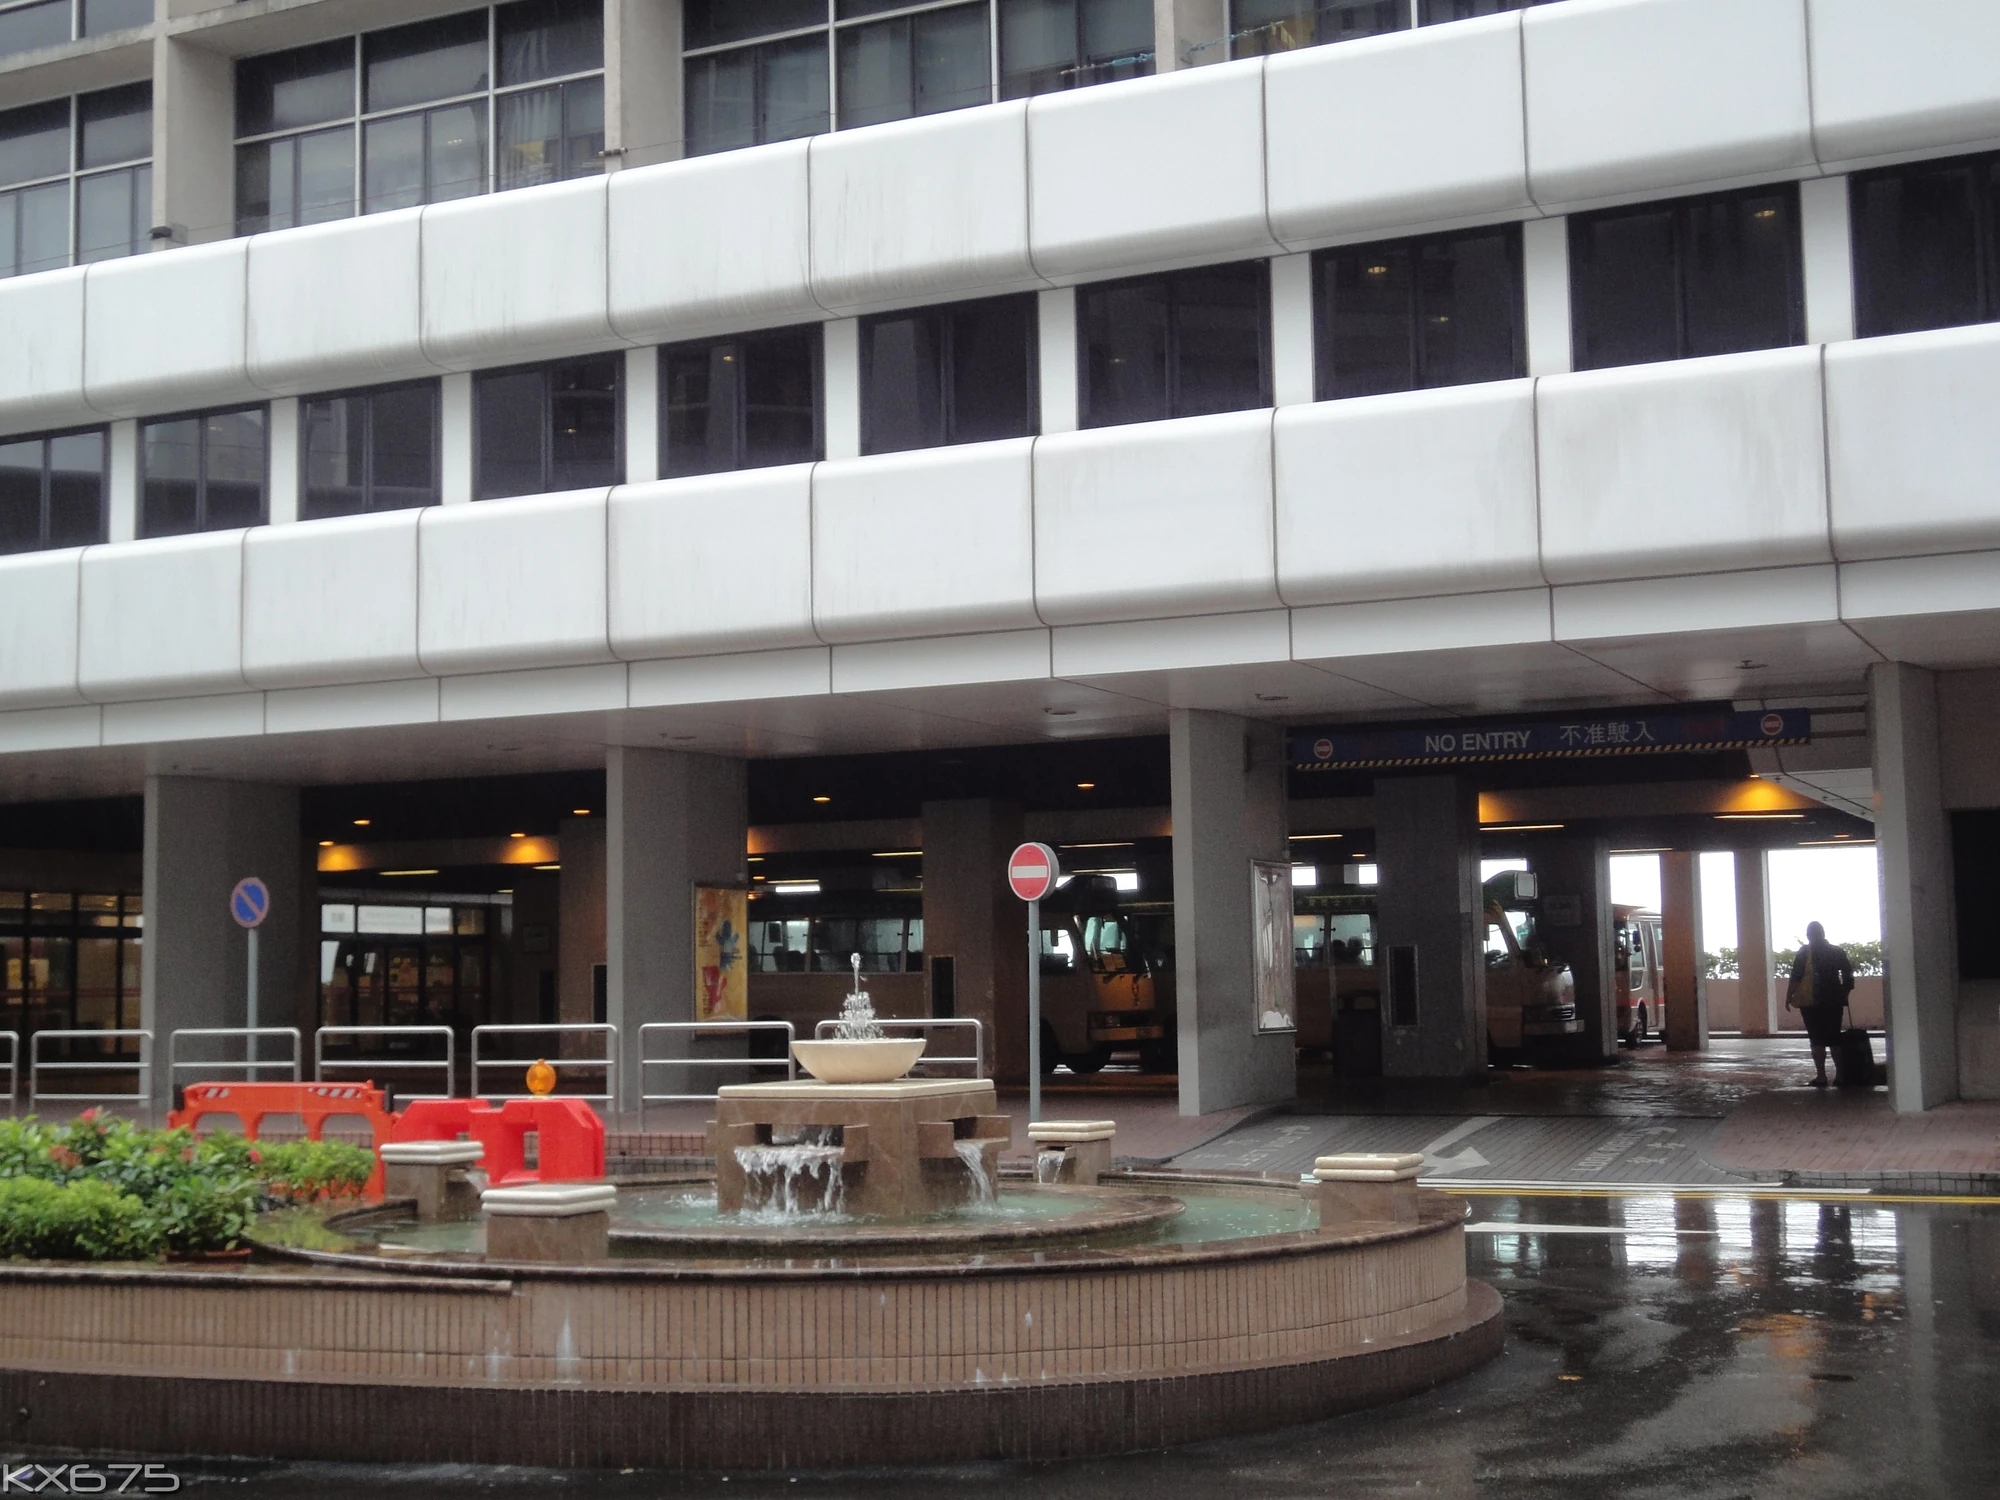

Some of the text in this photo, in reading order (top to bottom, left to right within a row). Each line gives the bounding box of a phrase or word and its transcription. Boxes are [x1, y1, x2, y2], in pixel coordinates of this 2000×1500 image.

[1425, 730, 1531, 752] NO ENTRY
[1560, 720, 1656, 746] 不准駛入
